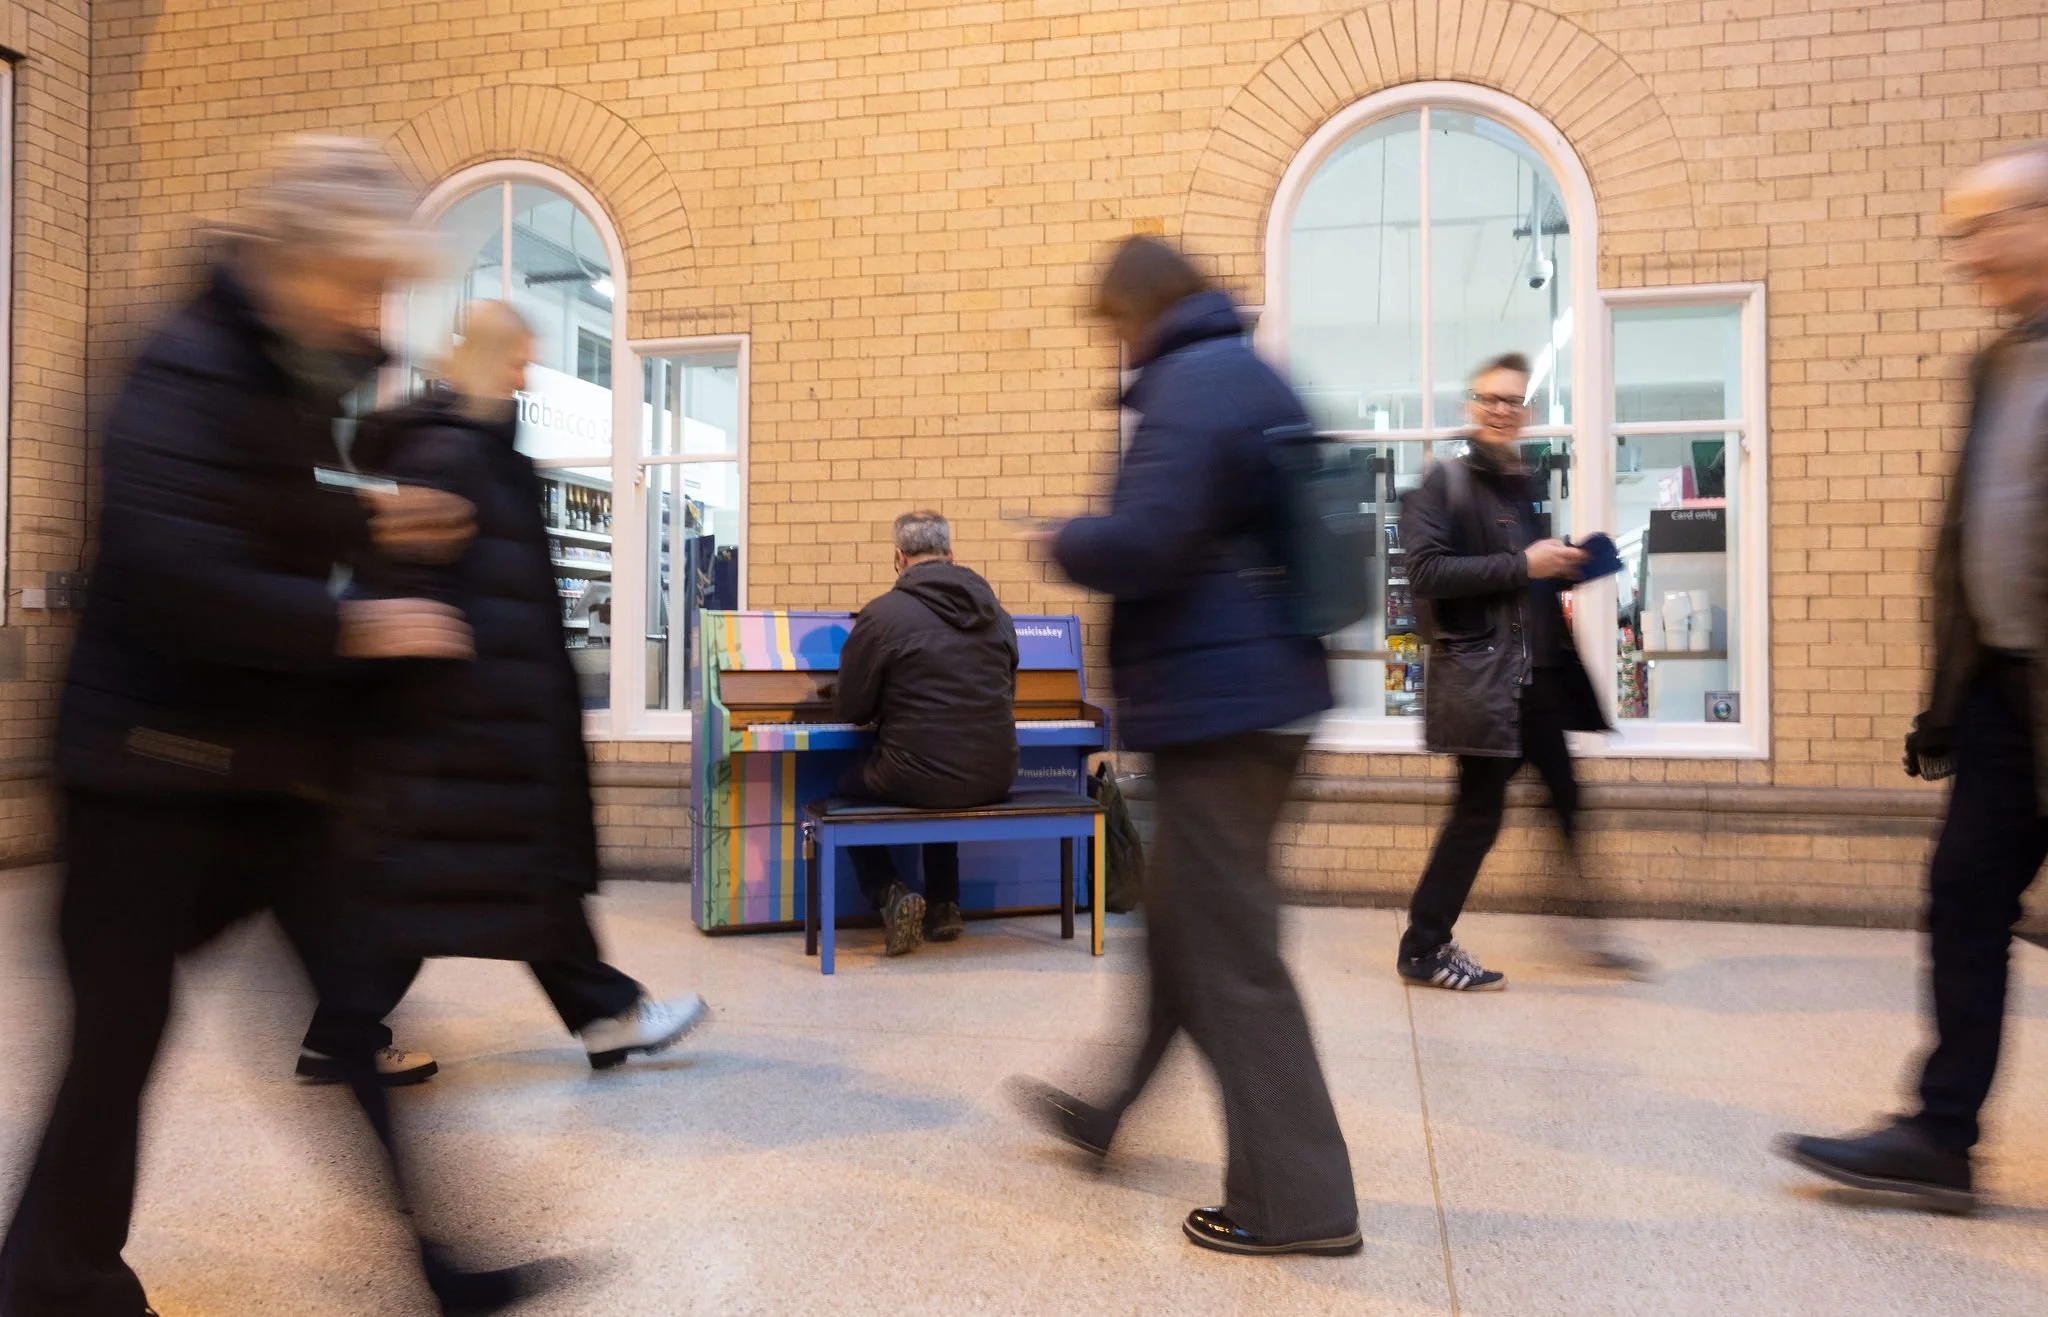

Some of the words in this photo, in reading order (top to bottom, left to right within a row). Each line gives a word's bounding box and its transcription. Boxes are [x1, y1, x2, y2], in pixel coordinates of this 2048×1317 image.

[513, 391, 596, 440] Tobacco
[1670, 510, 1693, 521] Card
[1694, 510, 1717, 522] only
